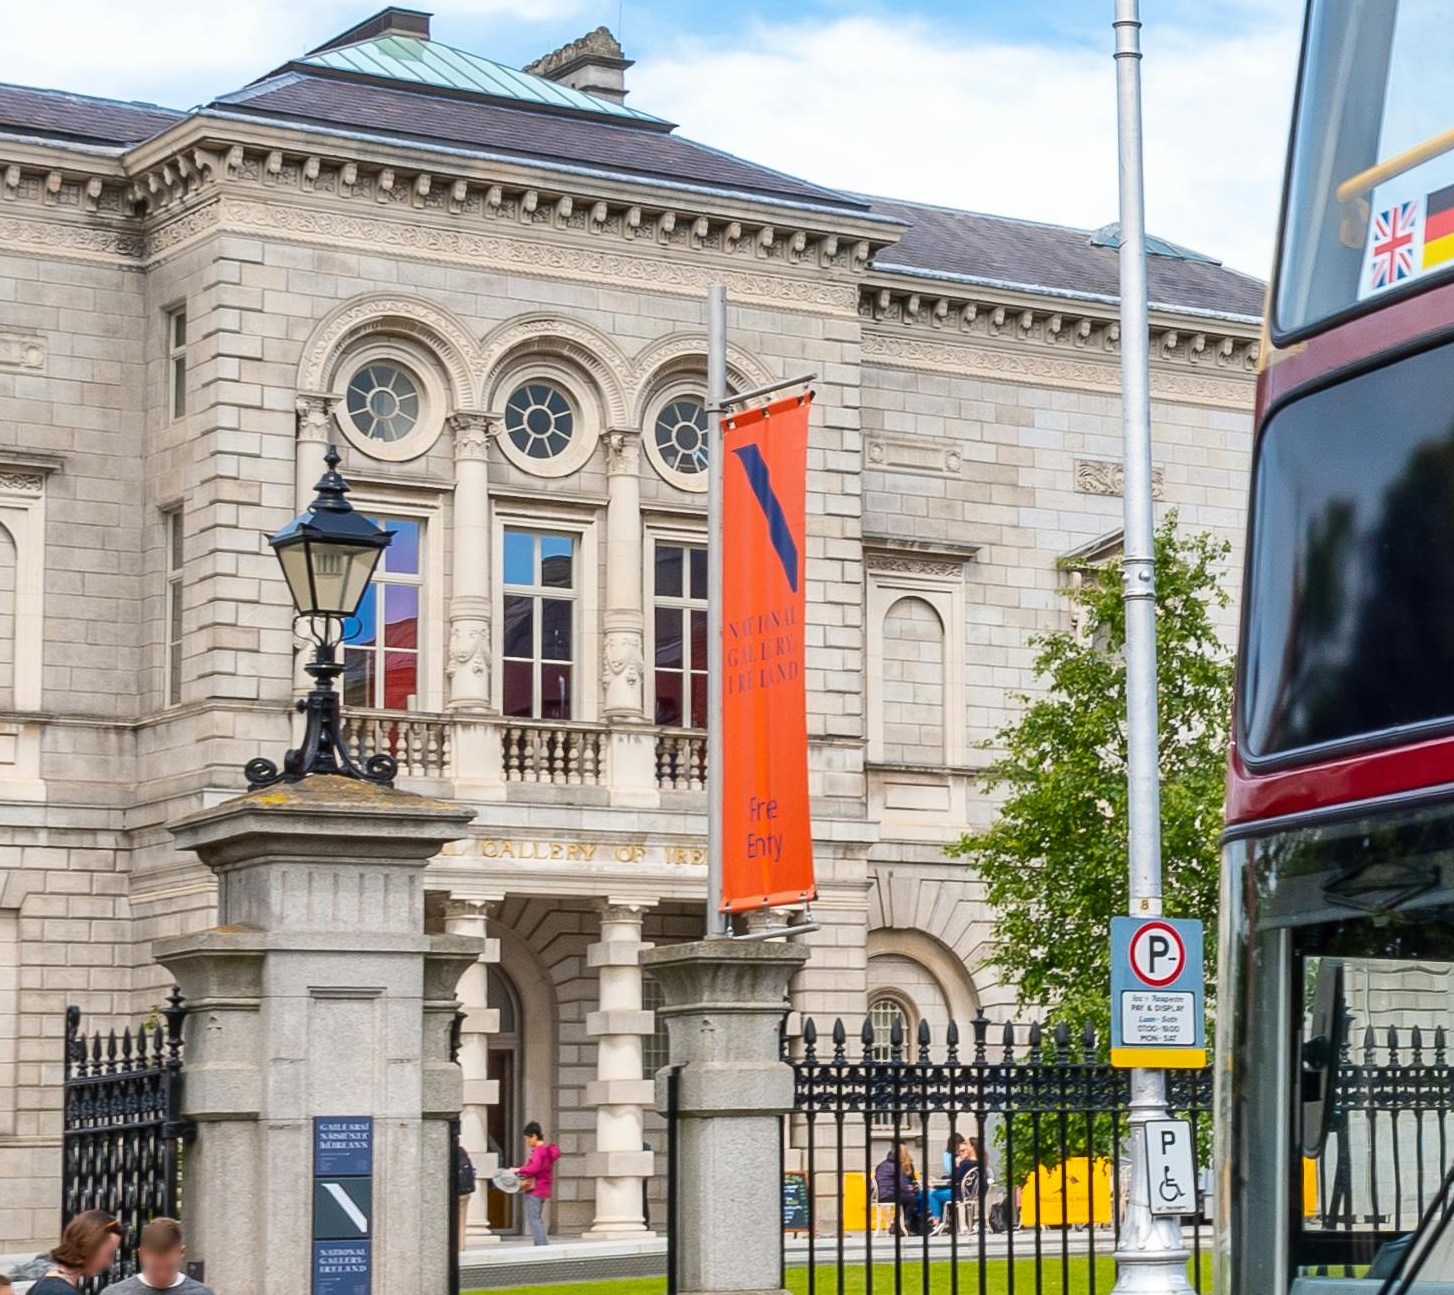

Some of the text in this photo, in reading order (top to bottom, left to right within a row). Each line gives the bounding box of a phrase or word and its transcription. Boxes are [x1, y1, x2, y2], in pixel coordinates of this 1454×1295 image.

[728, 661, 798, 695] IRELAND
[481, 840, 597, 862] GALLERY
[614, 845, 645, 864] OF
[1149, 935, 1170, 973] P
[1161, 1130, 1176, 1155] P
